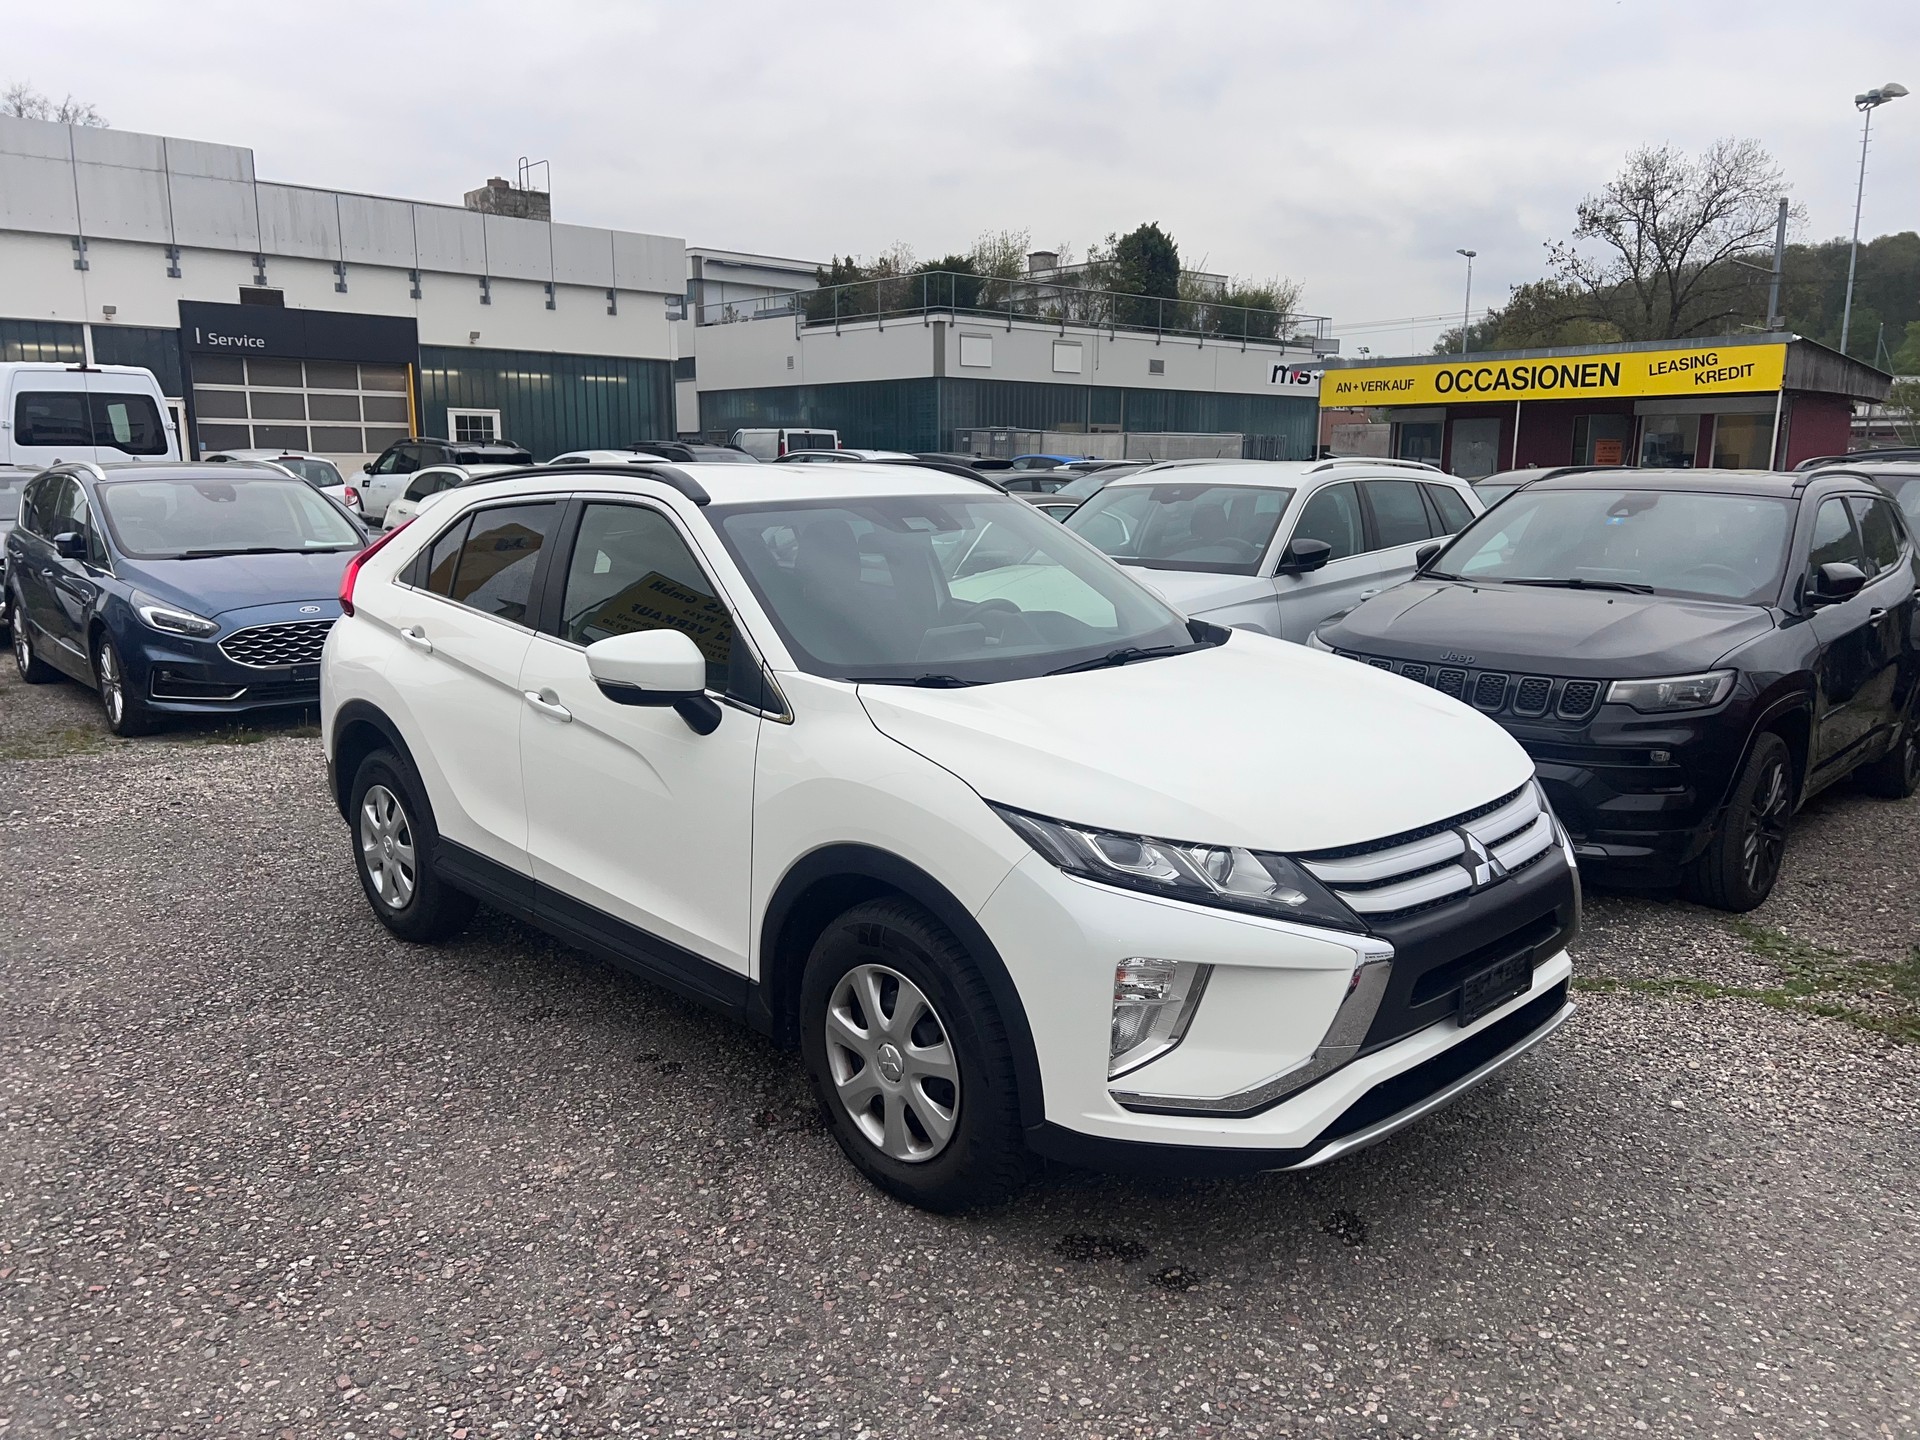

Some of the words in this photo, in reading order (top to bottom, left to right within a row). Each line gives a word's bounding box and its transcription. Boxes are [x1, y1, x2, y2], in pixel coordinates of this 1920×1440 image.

[208, 332, 265, 348] Service
[1648, 352, 1719, 376] LEASING
[1434, 362, 1621, 394] OCCASIONEN
[1694, 363, 1755, 386] KREDIT
[1335, 381, 1352, 393] AN
[1360, 378, 1415, 392] VERKAUF
[1440, 650, 1476, 665] Jeep
